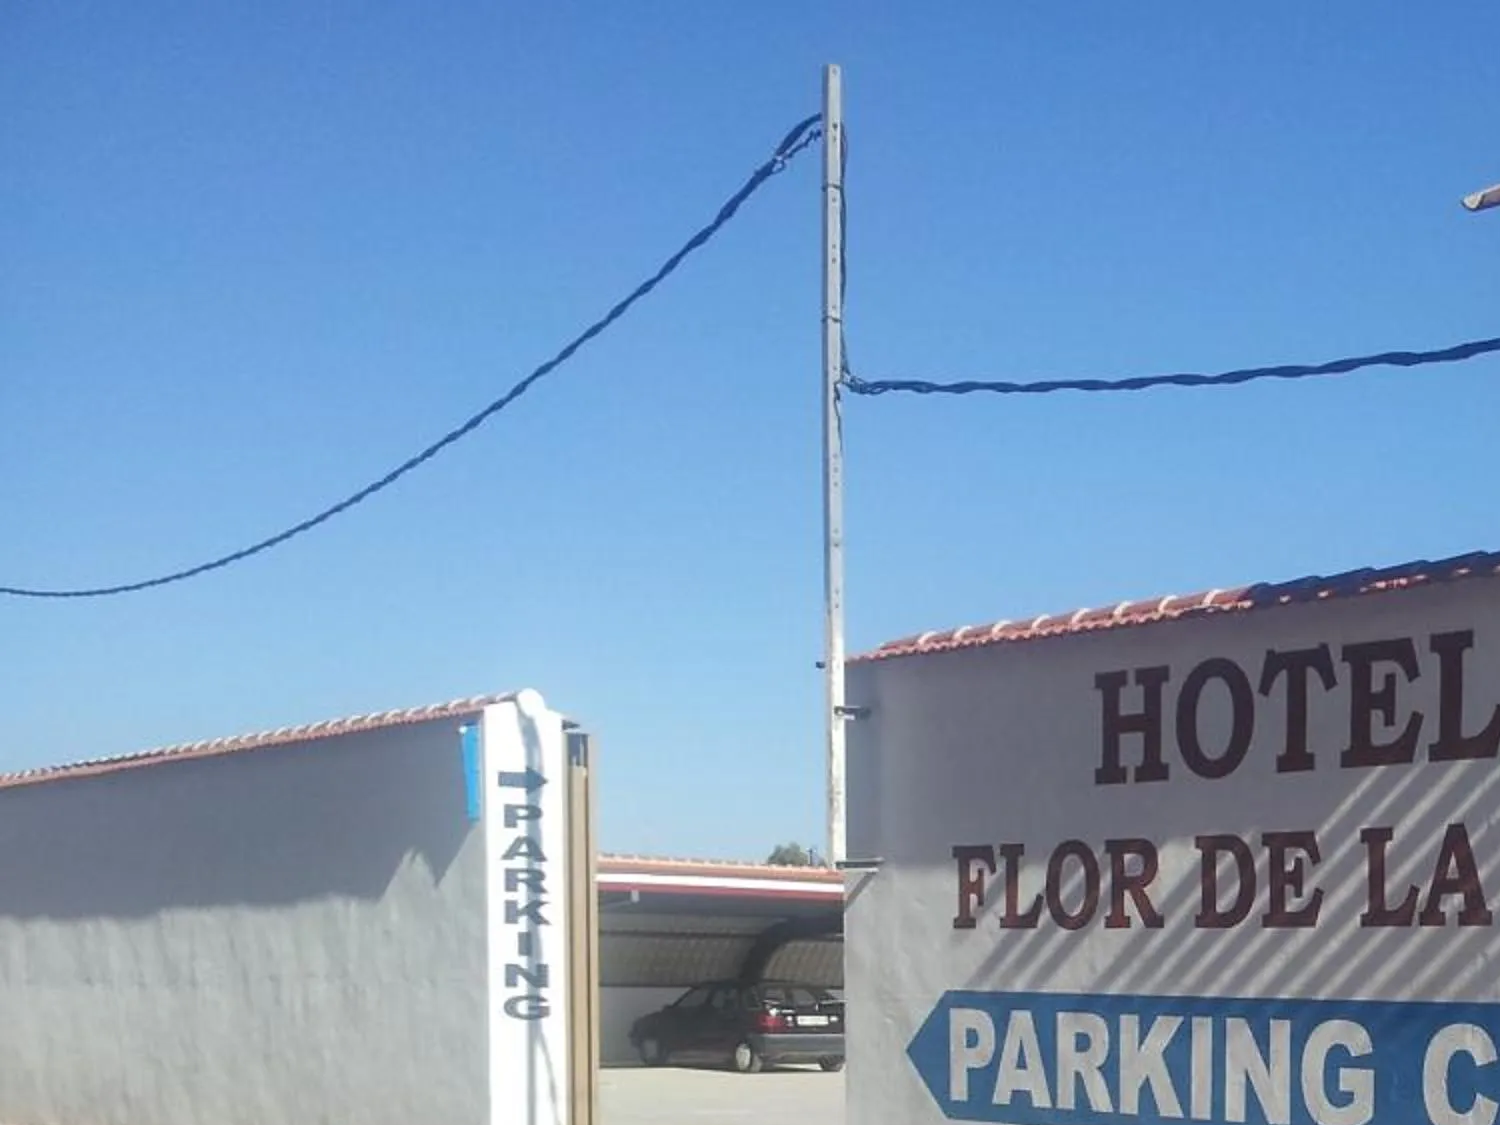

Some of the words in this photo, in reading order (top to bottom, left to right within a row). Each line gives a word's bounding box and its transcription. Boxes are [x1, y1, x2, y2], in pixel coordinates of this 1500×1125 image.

[503, 804, 552, 1020] PARKING
[952, 838, 1164, 930] FLOR
[1194, 831, 1324, 928] DE
[1360, 823, 1493, 927] LA
